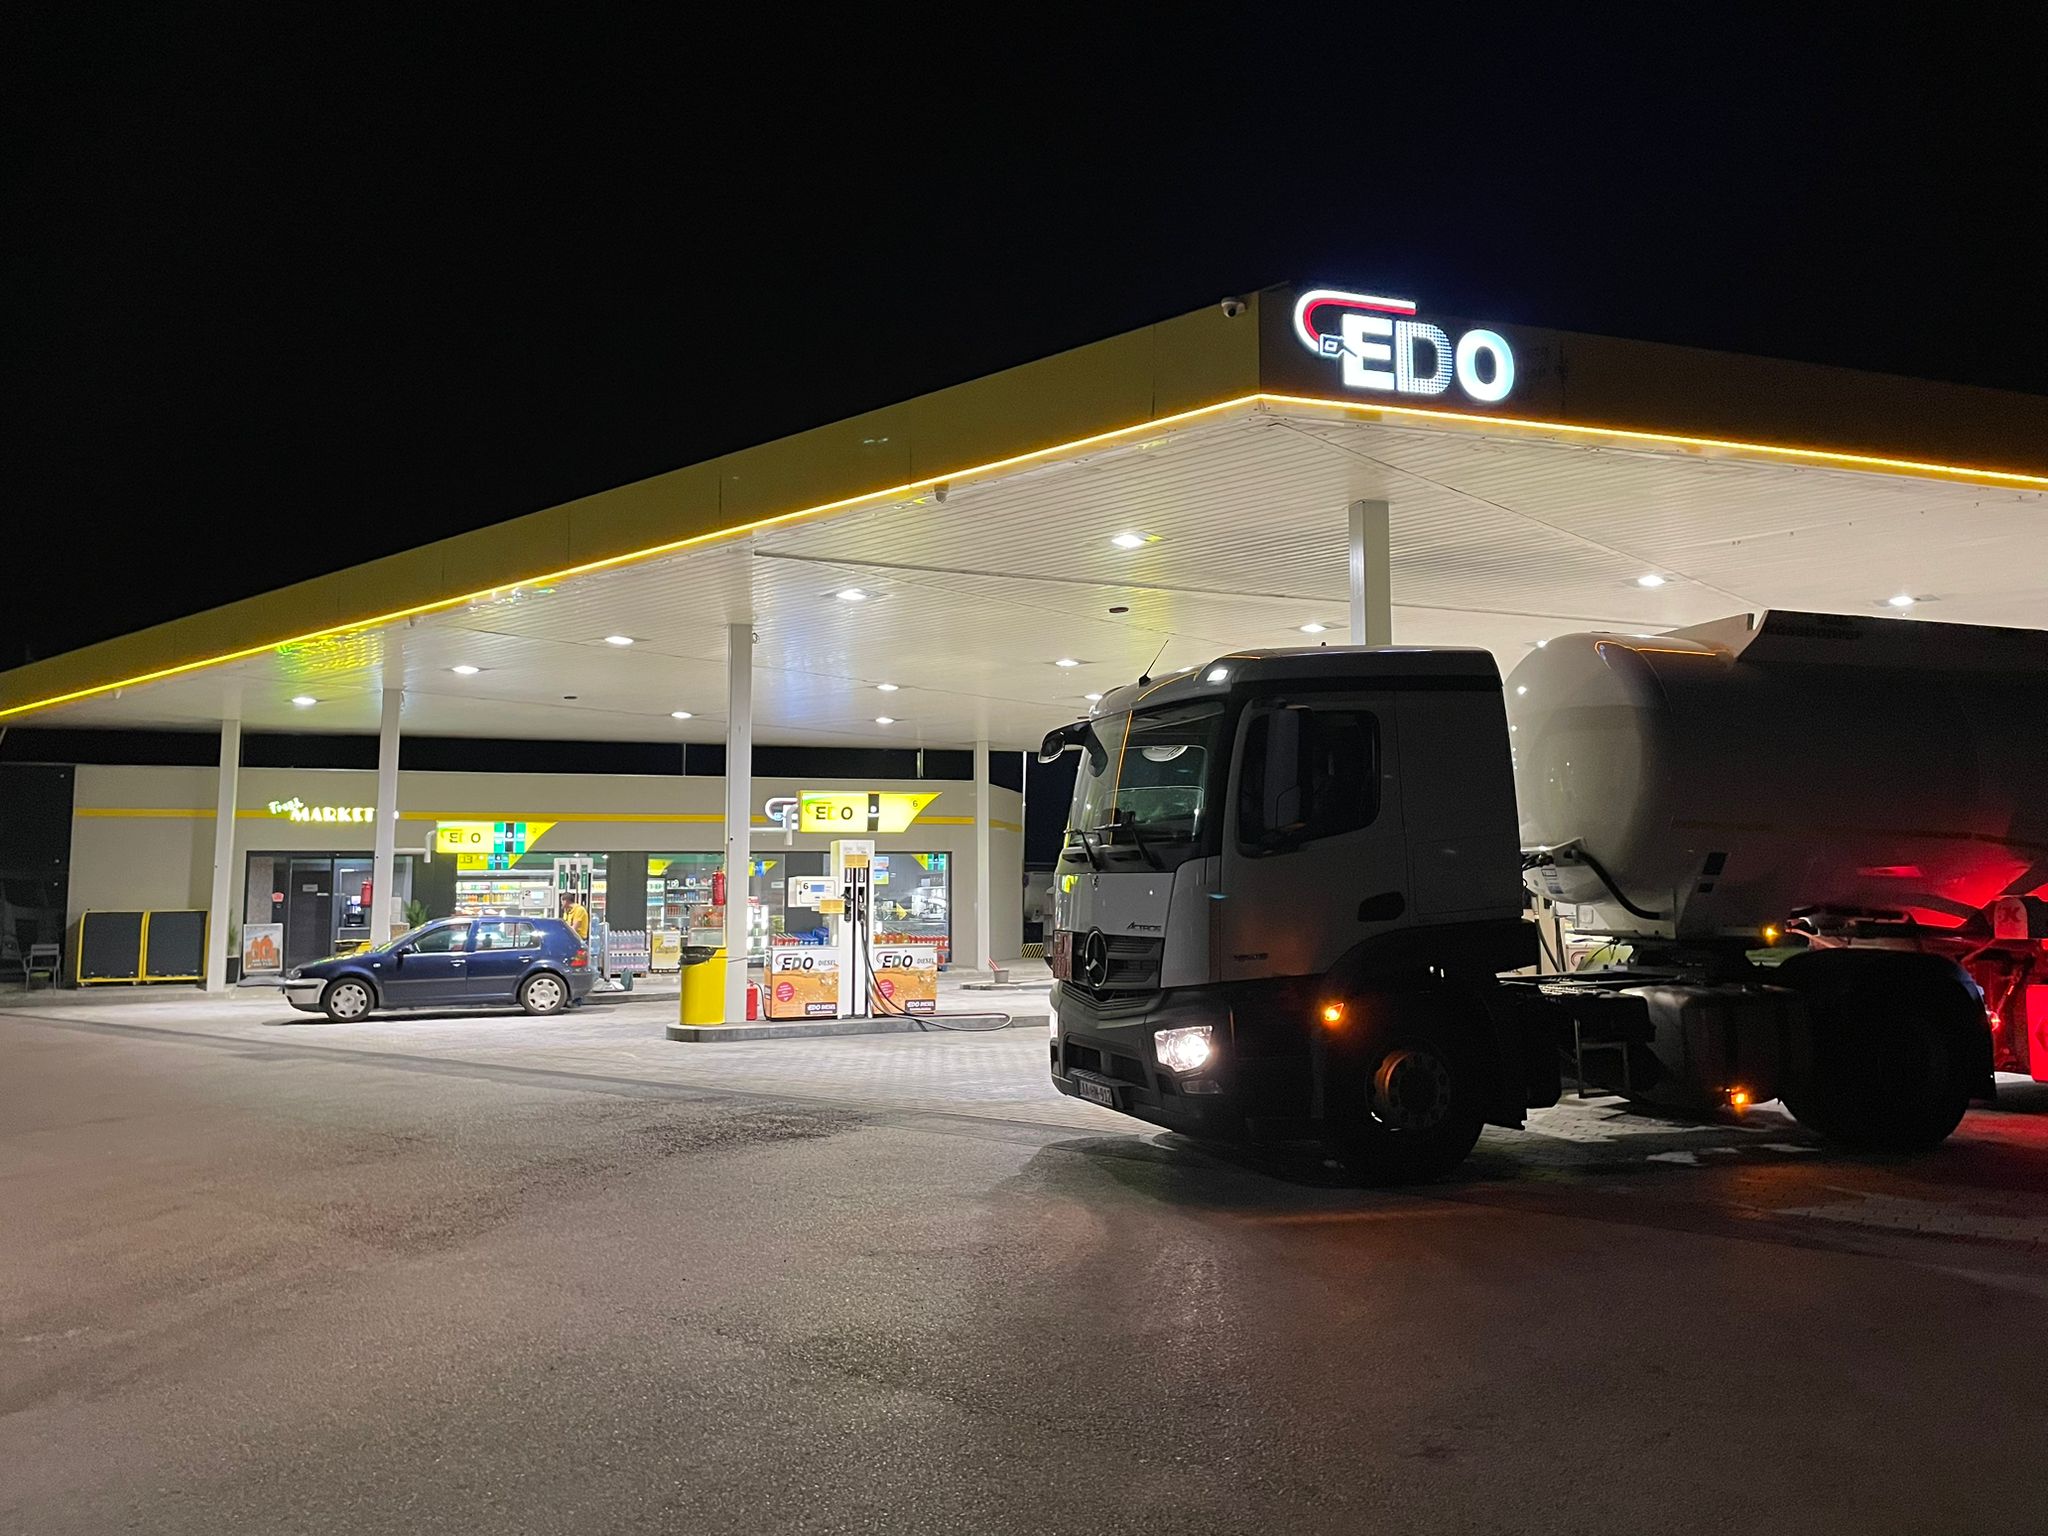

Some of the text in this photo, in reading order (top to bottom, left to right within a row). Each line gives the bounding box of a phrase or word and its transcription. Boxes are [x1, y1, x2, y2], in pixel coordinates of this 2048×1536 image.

[1342, 313, 1515, 402] EDO
[290, 806, 375, 822] MARKET
[803, 882, 809, 890] 6
[781, 956, 814, 971] EDO
[881, 955, 913, 968] EDO
